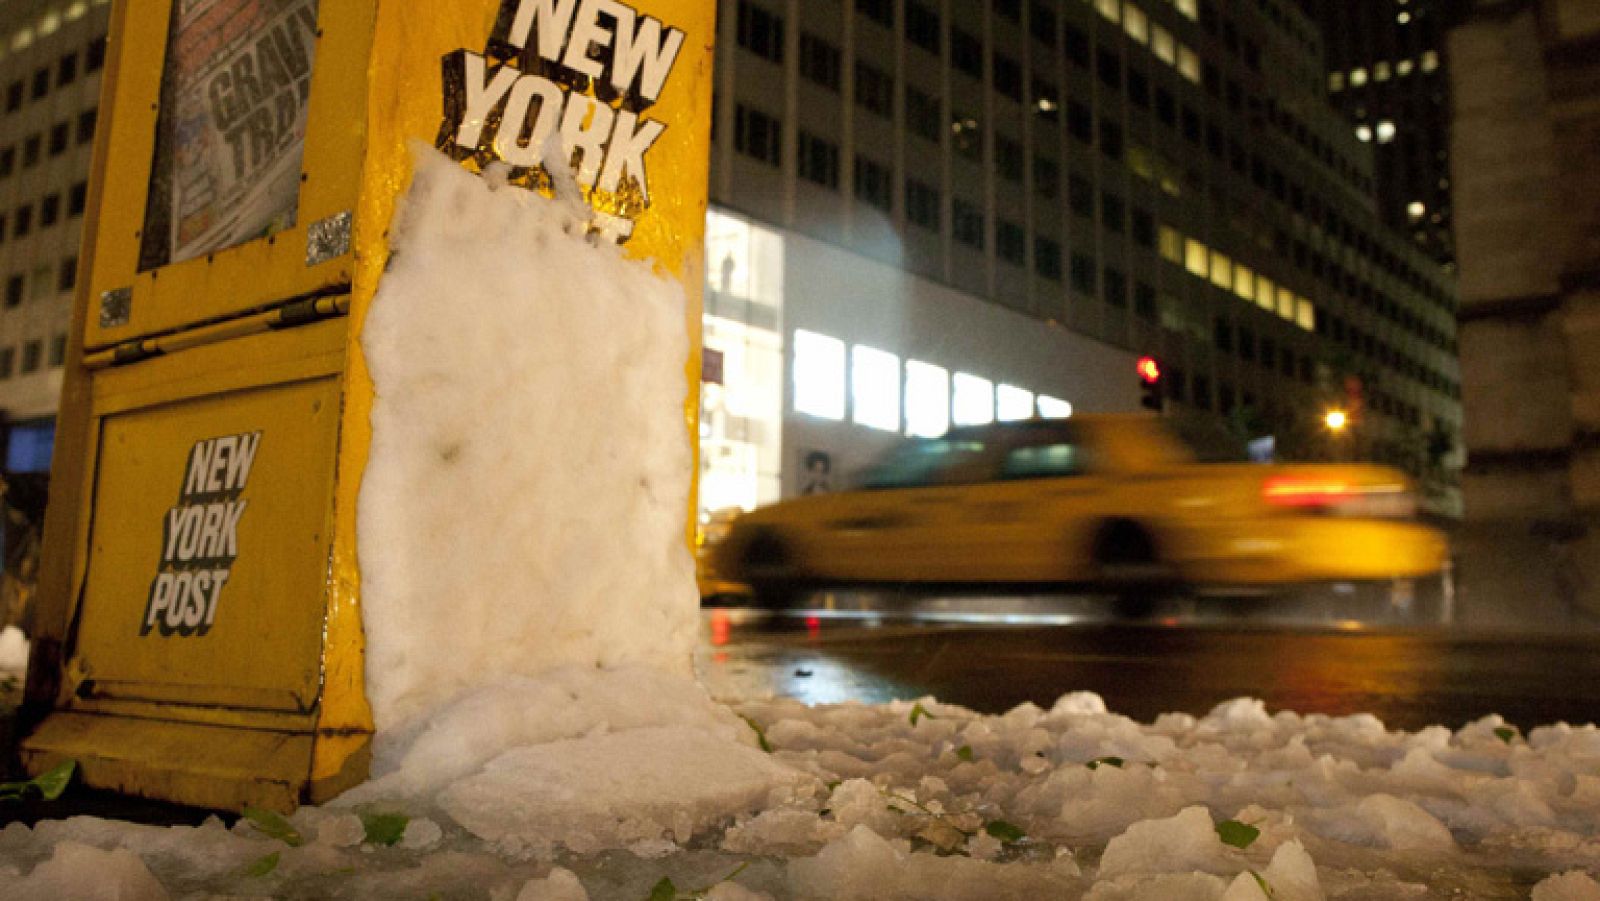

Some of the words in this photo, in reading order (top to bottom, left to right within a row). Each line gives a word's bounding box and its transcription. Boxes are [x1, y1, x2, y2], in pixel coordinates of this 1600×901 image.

[507, 0, 686, 102] NEW
[454, 51, 668, 202] YORK
[184, 431, 262, 495] NEW
[164, 500, 249, 562] YORK
[146, 567, 231, 628] POST
